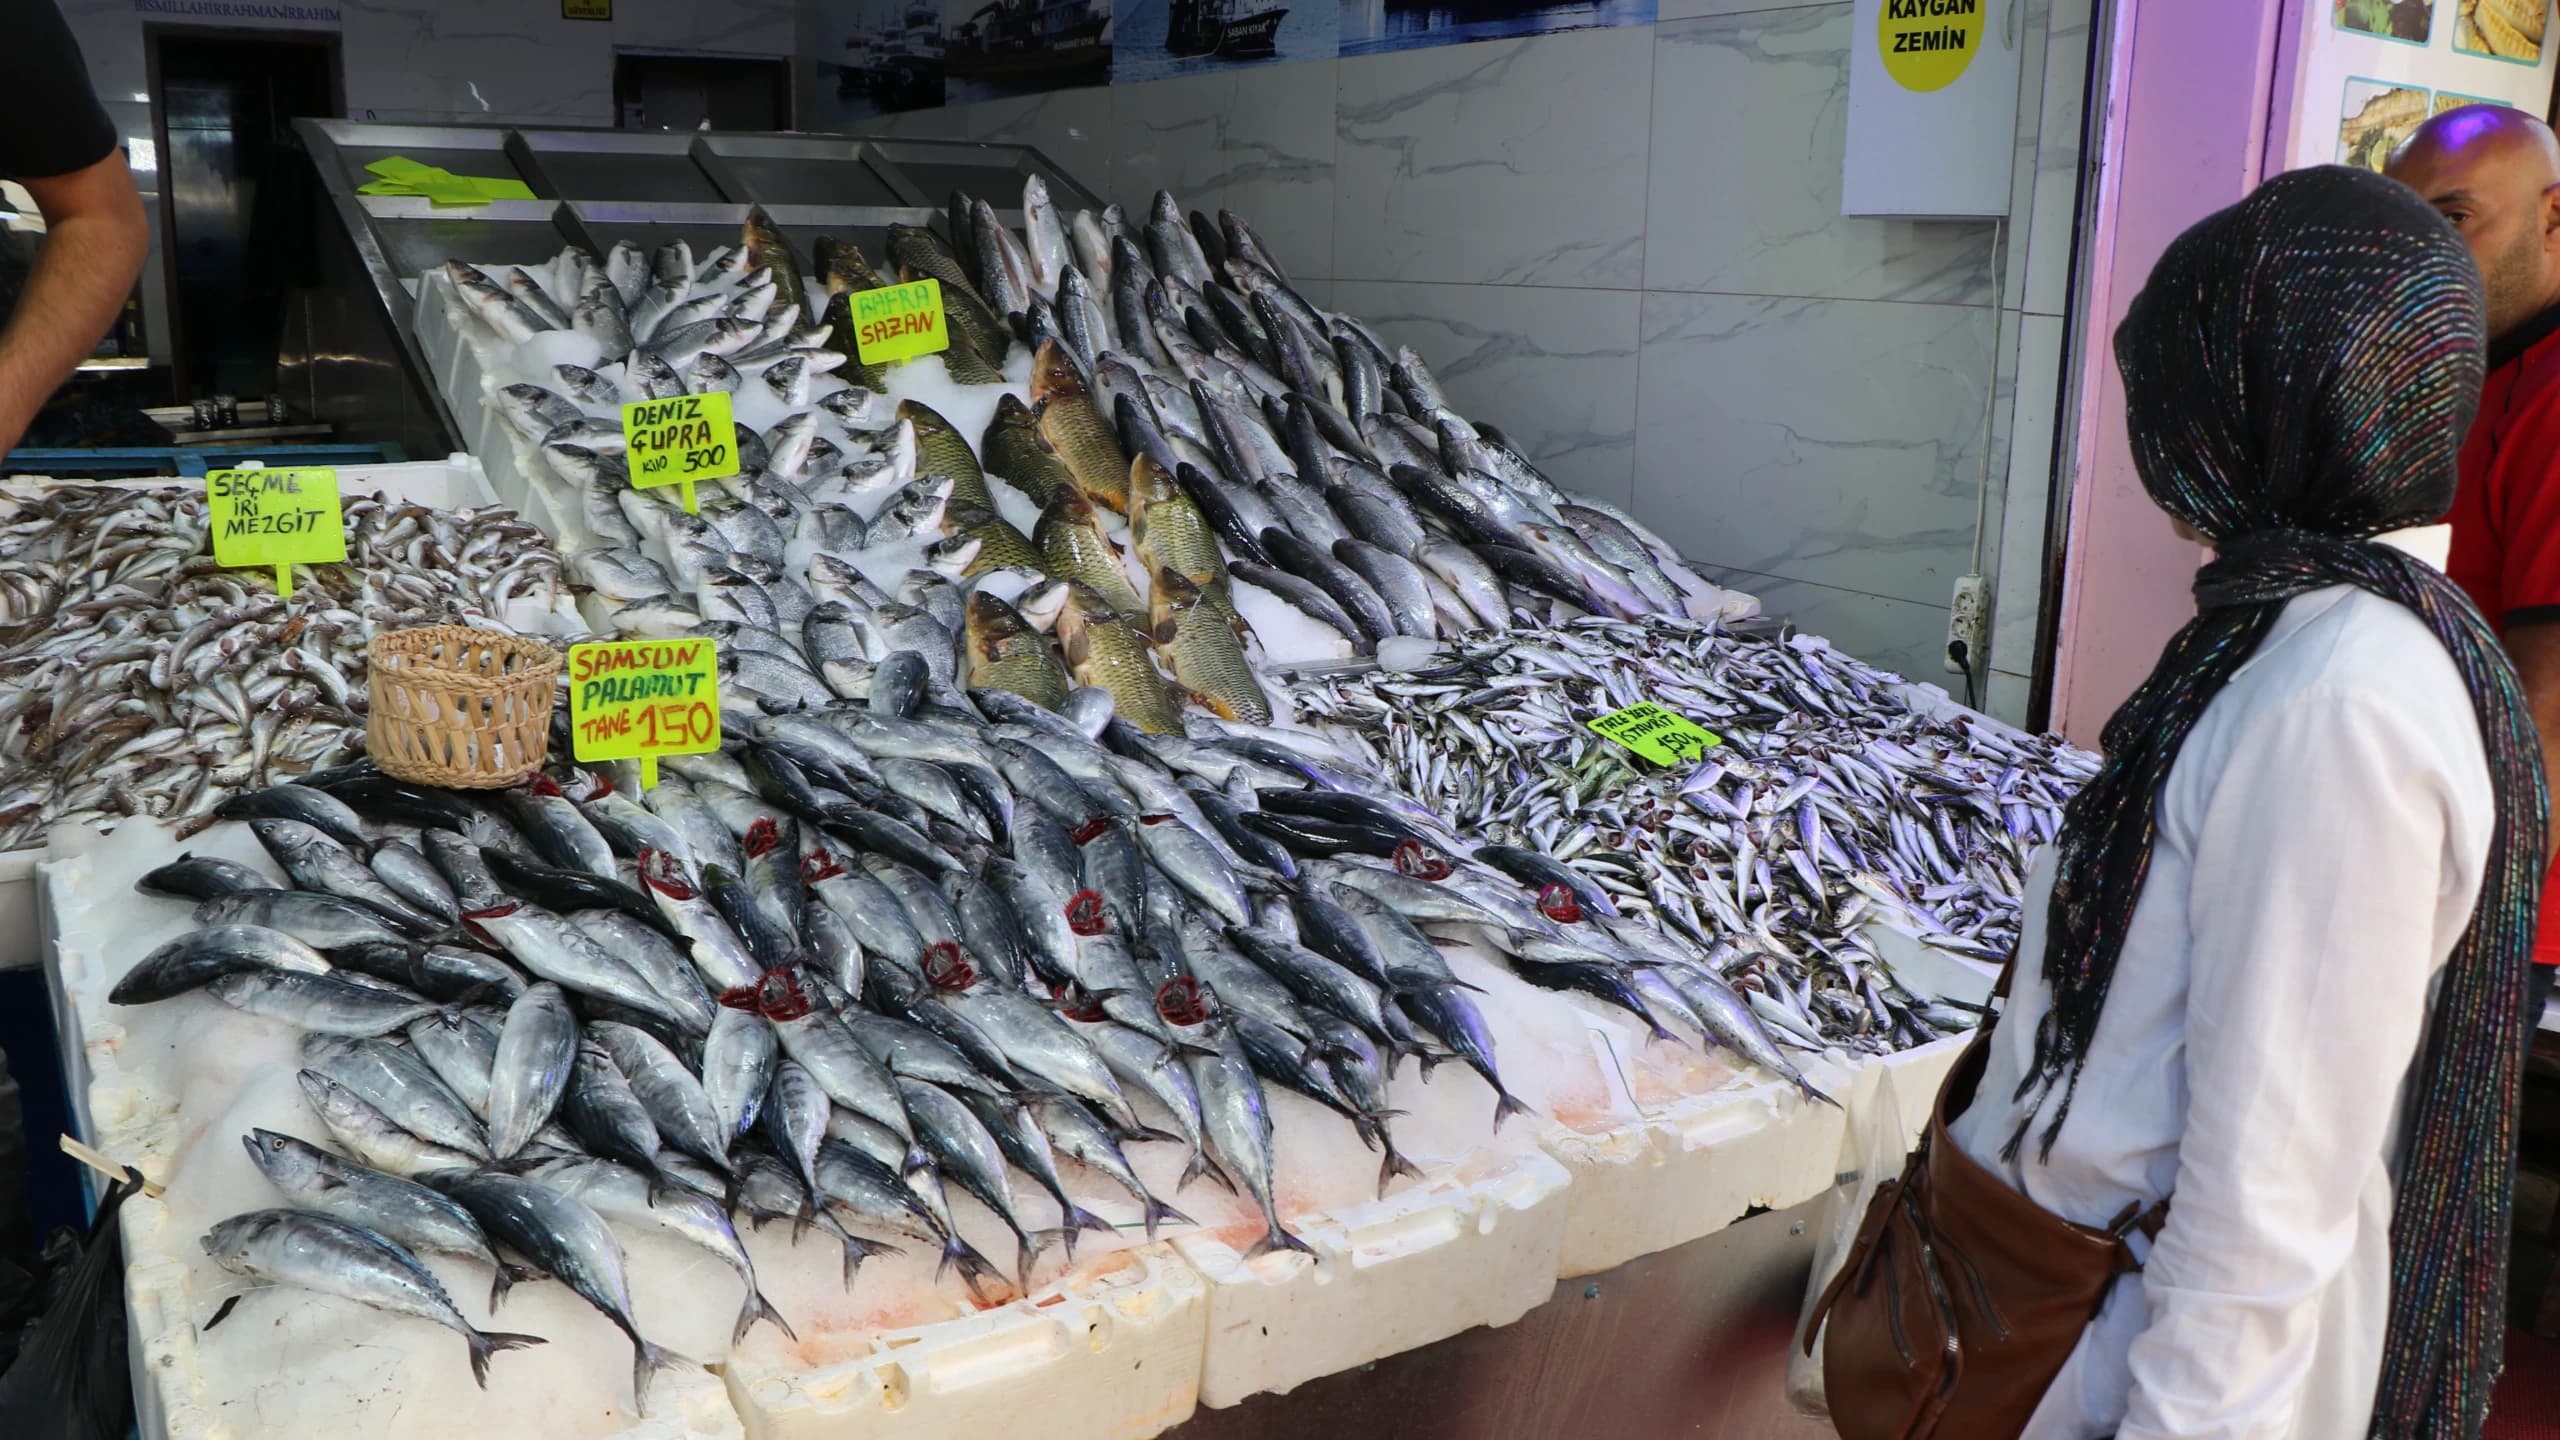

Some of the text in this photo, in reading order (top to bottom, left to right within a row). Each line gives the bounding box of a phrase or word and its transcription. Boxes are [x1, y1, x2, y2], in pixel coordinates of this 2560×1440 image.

[1887, 0, 1976, 19] KAYGAN
[1893, 25, 1966, 53] ZEMİN
[861, 310, 936, 346] SAZAN
[632, 398, 704, 427] DENİZ
[630, 420, 712, 456] ÇUPRA
[682, 444, 727, 473] 500
[214, 472, 302, 498] SEÇME
[234, 496, 259, 517] İRİ
[224, 507, 326, 540] MEZGİT
[575, 643, 701, 682] SAMSUN
[581, 672, 706, 711] PALAMUT
[580, 701, 714, 748] TANE 150
